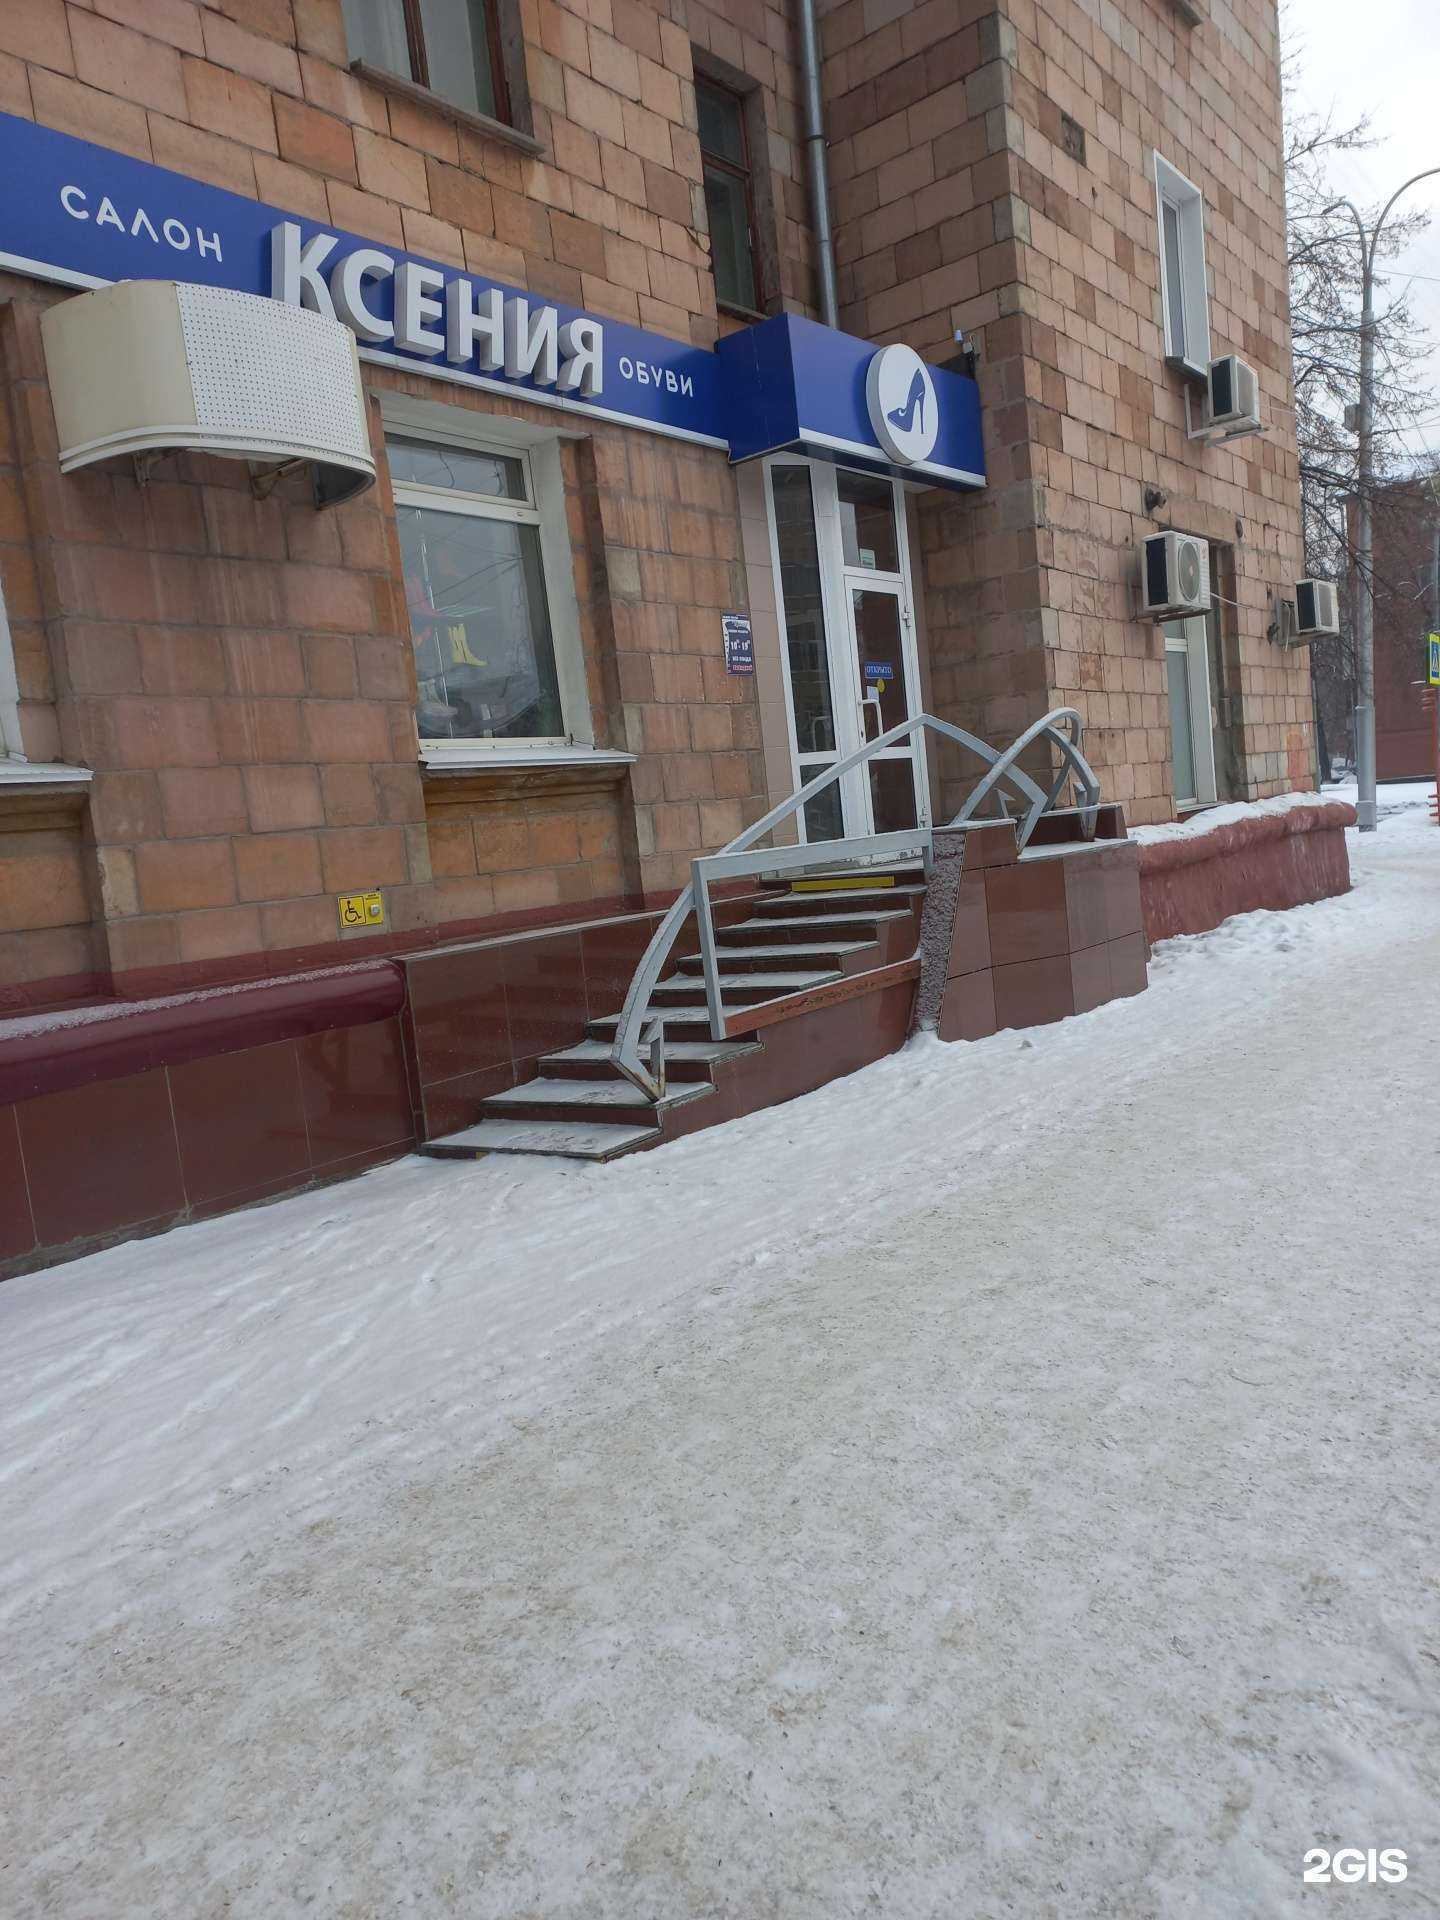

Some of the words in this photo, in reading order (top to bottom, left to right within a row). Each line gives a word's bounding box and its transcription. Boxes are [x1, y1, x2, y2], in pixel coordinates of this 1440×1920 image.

[61, 185, 223, 262] САЛОН
[271, 221, 604, 397] КСЕНИЯ
[619, 356, 694, 398] ОБУВИ
